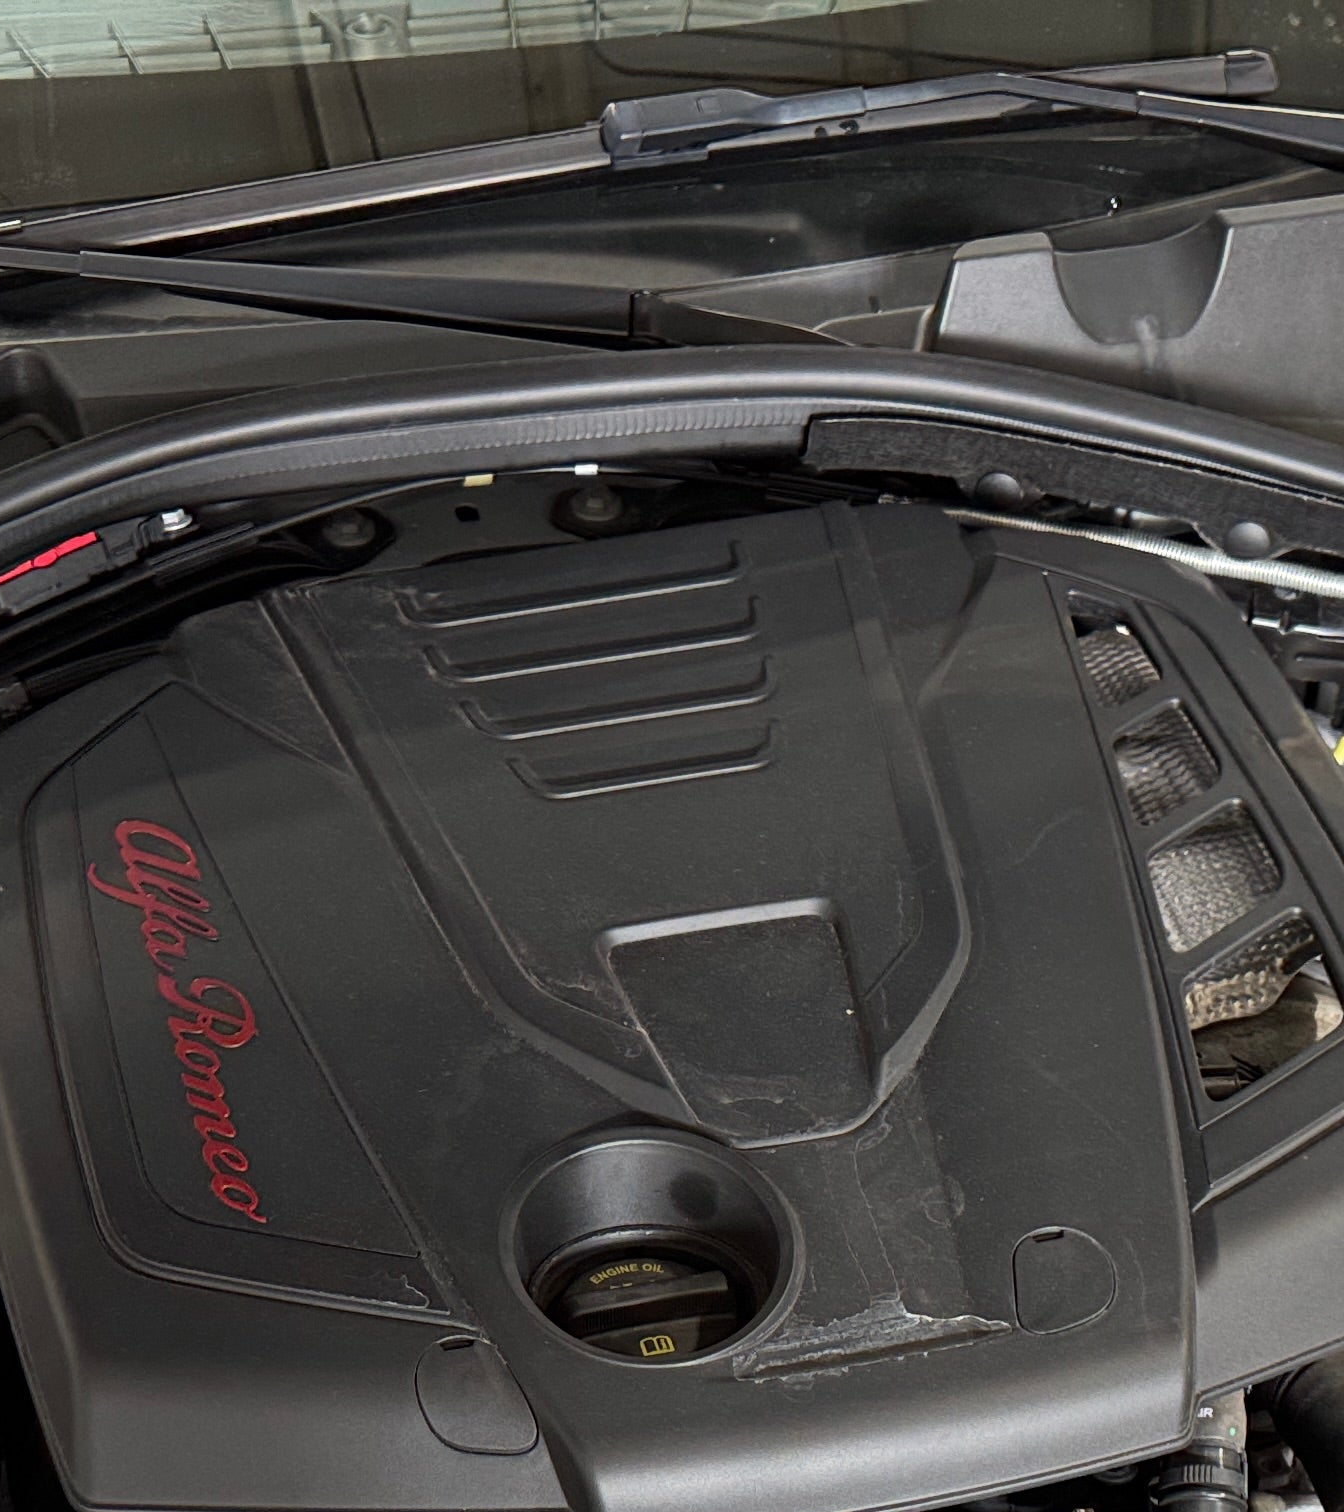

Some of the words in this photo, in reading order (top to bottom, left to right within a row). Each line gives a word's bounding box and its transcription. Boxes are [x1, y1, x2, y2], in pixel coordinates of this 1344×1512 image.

[87, 819, 219, 974] Alfa
[157, 976, 268, 1223] Romeo
[589, 1262, 639, 1285] ENGINE
[641, 1262, 665, 1274] OIL
